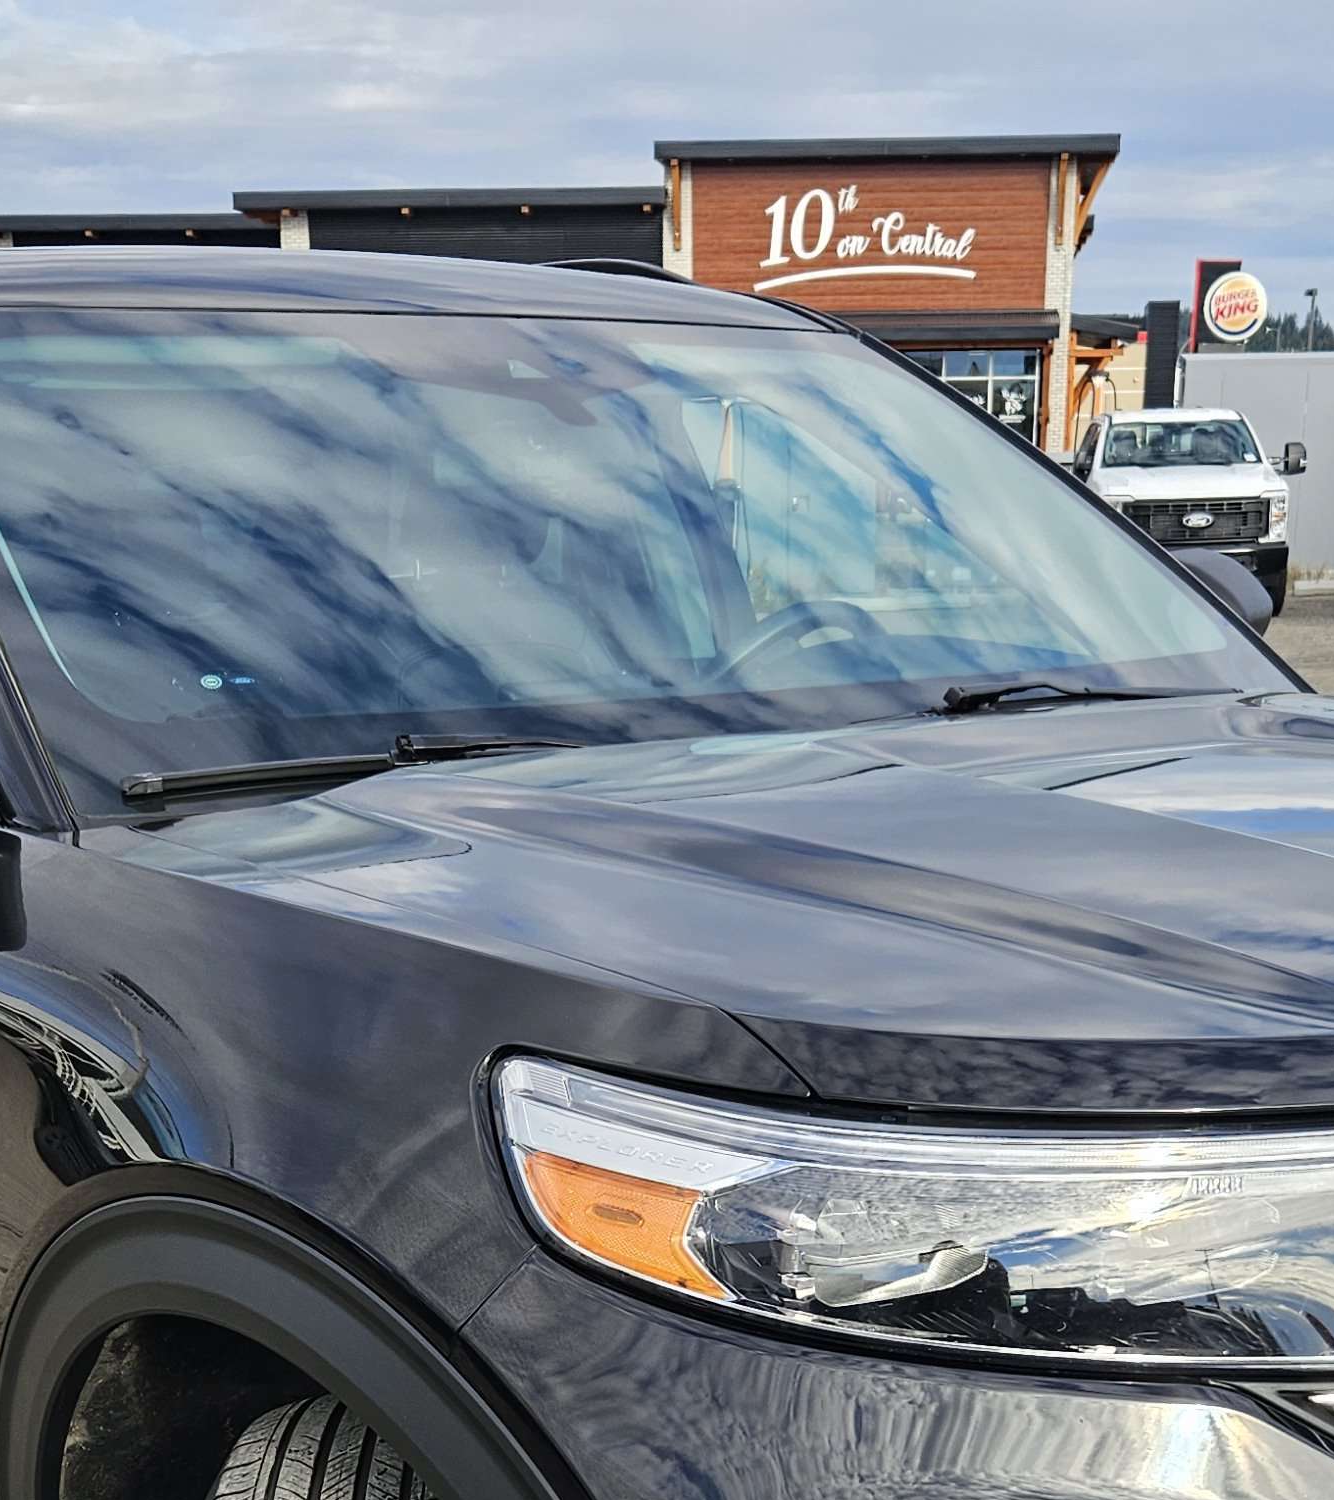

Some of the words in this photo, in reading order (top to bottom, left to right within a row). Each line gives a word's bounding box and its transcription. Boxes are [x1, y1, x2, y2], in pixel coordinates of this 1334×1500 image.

[837, 235, 871, 259] on
[871, 211, 976, 261] Central
[1214, 299, 1259, 321] KING
[539, 1121, 716, 1175] EXPLORER
